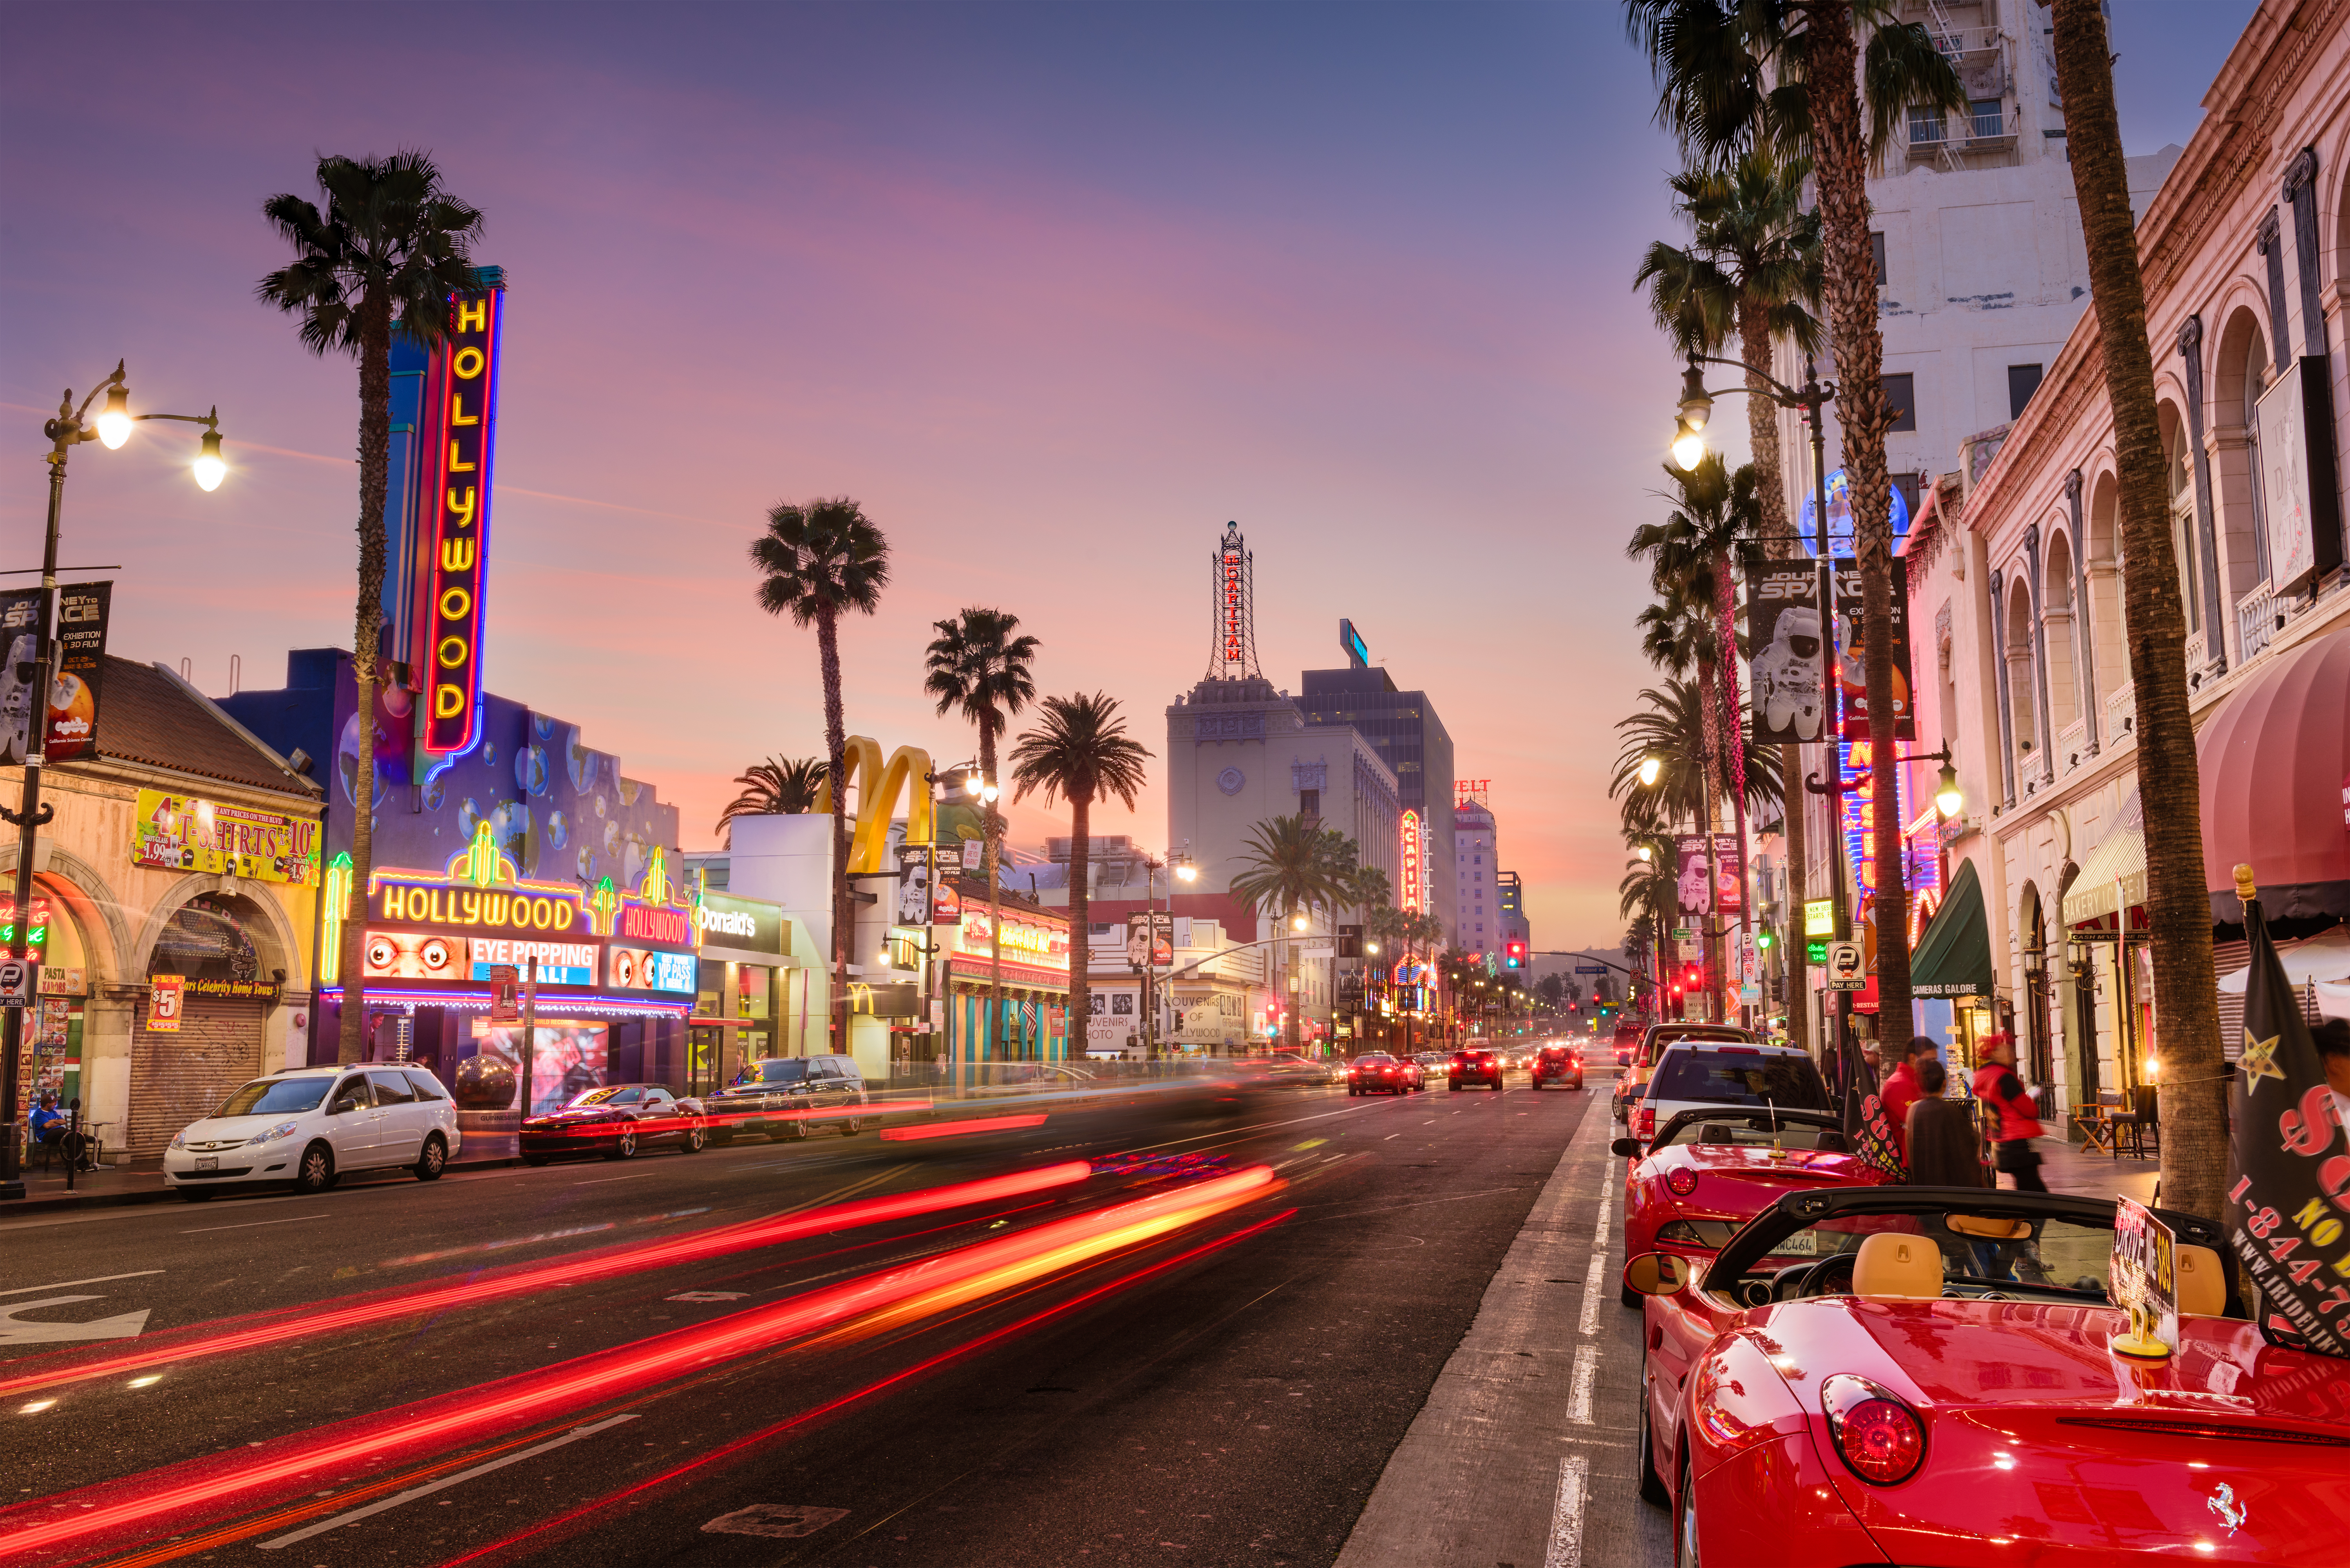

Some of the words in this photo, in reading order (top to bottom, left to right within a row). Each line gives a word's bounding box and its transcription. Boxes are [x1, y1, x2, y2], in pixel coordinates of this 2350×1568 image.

[2272, 409, 2294, 448] THE
[2274, 449, 2299, 502] DAY
[436, 299, 486, 720] HOLLYWOOD
[1224, 555, 1238, 564] EL
[1226, 567, 1238, 659] CAPITAN
[63, 631, 101, 640] EXHIBITION
[219, 807, 230, 815] ANY
[231, 810, 249, 819] PRICES
[269, 817, 282, 825] BLVD
[1405, 820, 1415, 830] EL
[143, 842, 166, 861] $1.99
[1405, 831, 1417, 907] CAPITA
[383, 884, 573, 930] HOLLYWOOD
[2064, 891, 2099, 923] BAKERY
[625, 905, 686, 943] HOLLYWOOD
[1000, 925, 1022, 947] Believe
[473, 938, 508, 963] EYE
[515, 942, 593, 966] POPPING
[662, 954, 672, 963] GET
[674, 956, 688, 965] YOUR
[44, 968, 65, 980] PASTA
[659, 963, 671, 977] VIP
[672, 964, 691, 979] PASS
[42, 981, 66, 994] KABOBS
[197, 979, 231, 996] Celebrity
[232, 981, 252, 994] Home
[254, 982, 273, 995] Tours
[666, 978, 683, 989] HERE
[1912, 985, 1942, 995] CAMERAS
[1945, 984, 1977, 994] GALORE
[152, 990, 176, 1017] $5
[1190, 1012, 1203, 1021] OF
[2291, 1197, 2344, 1248] NO
[2157, 1228, 2171, 1293] $89
